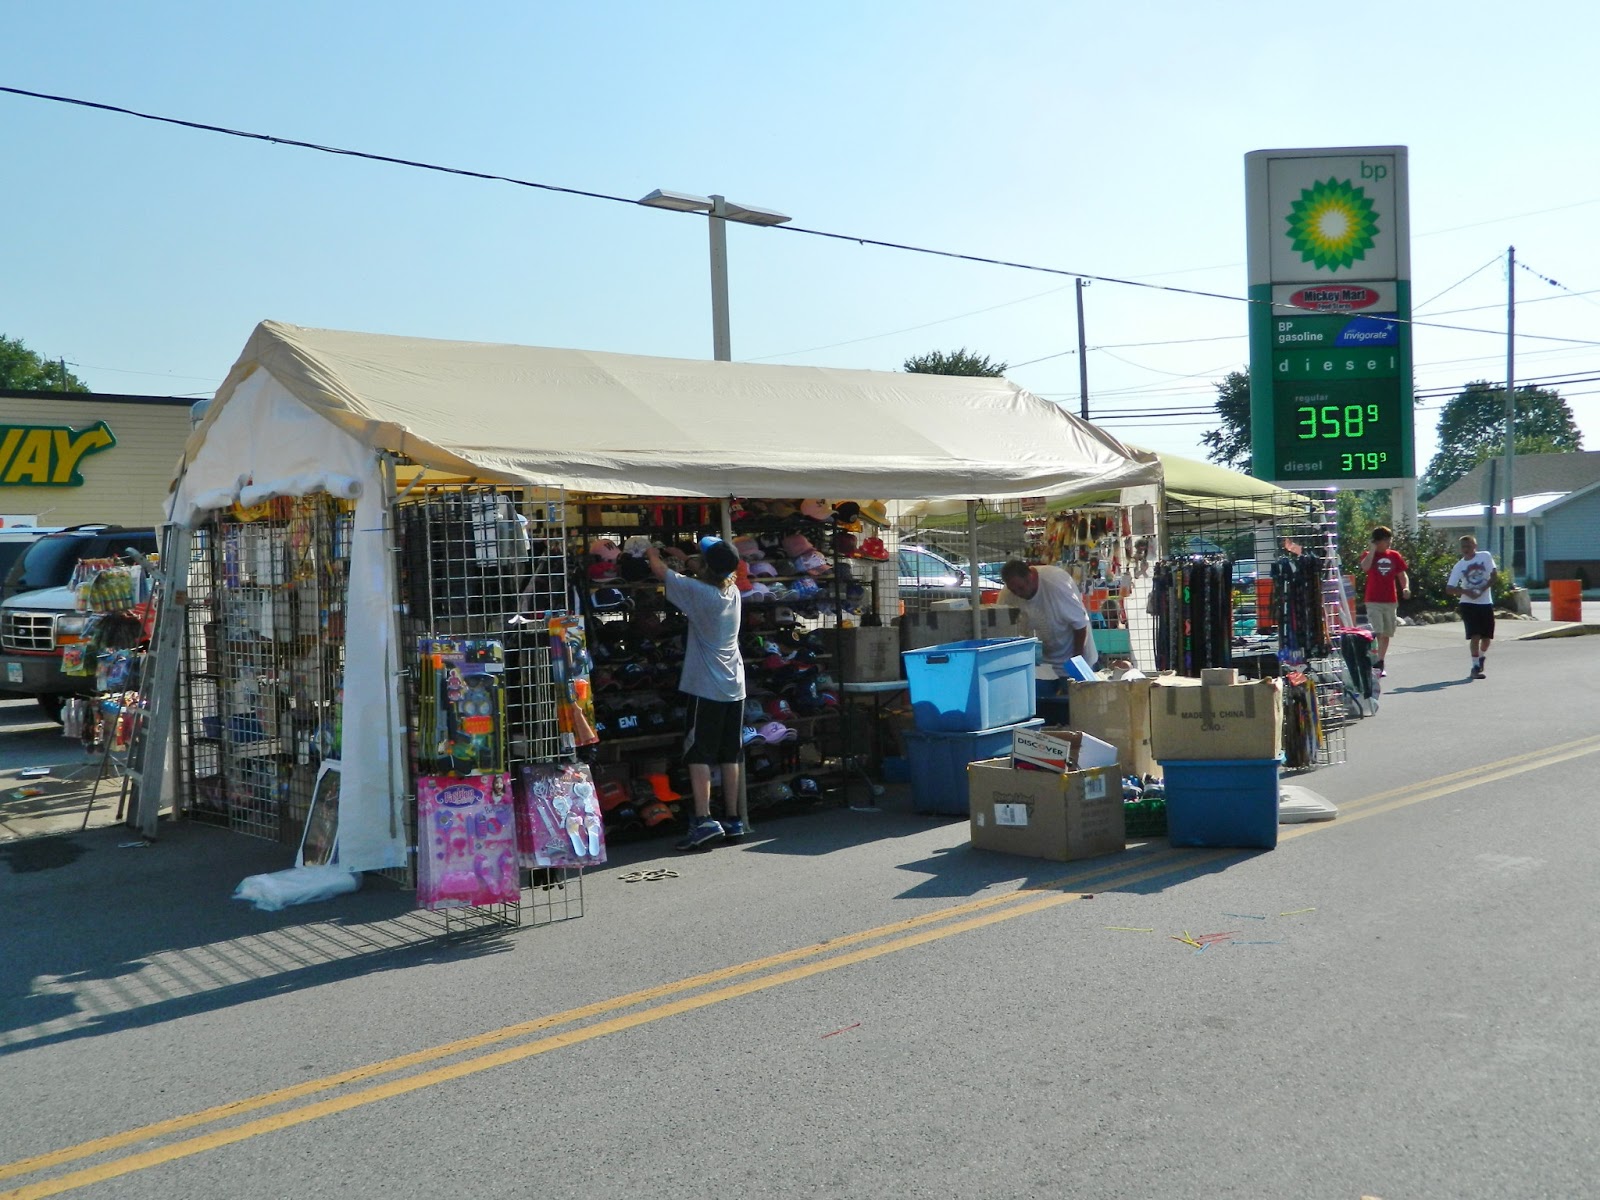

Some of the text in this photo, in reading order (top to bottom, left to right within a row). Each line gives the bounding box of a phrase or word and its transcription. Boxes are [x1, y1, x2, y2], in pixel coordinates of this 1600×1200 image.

[1361, 160, 1387, 182] bp
[1304, 289, 1366, 302] Mickey Mart
[1278, 322, 1293, 332] BP
[1278, 331, 1323, 344] gasoline
[1343, 331, 1388, 342] Invigorate
[1295, 394, 1329, 403] regular
[1284, 461, 1323, 472] diesel
[1219, 710, 1244, 719] CHINA
[618, 715, 638, 729] EMT
[1017, 737, 1063, 757] DISCOVER
